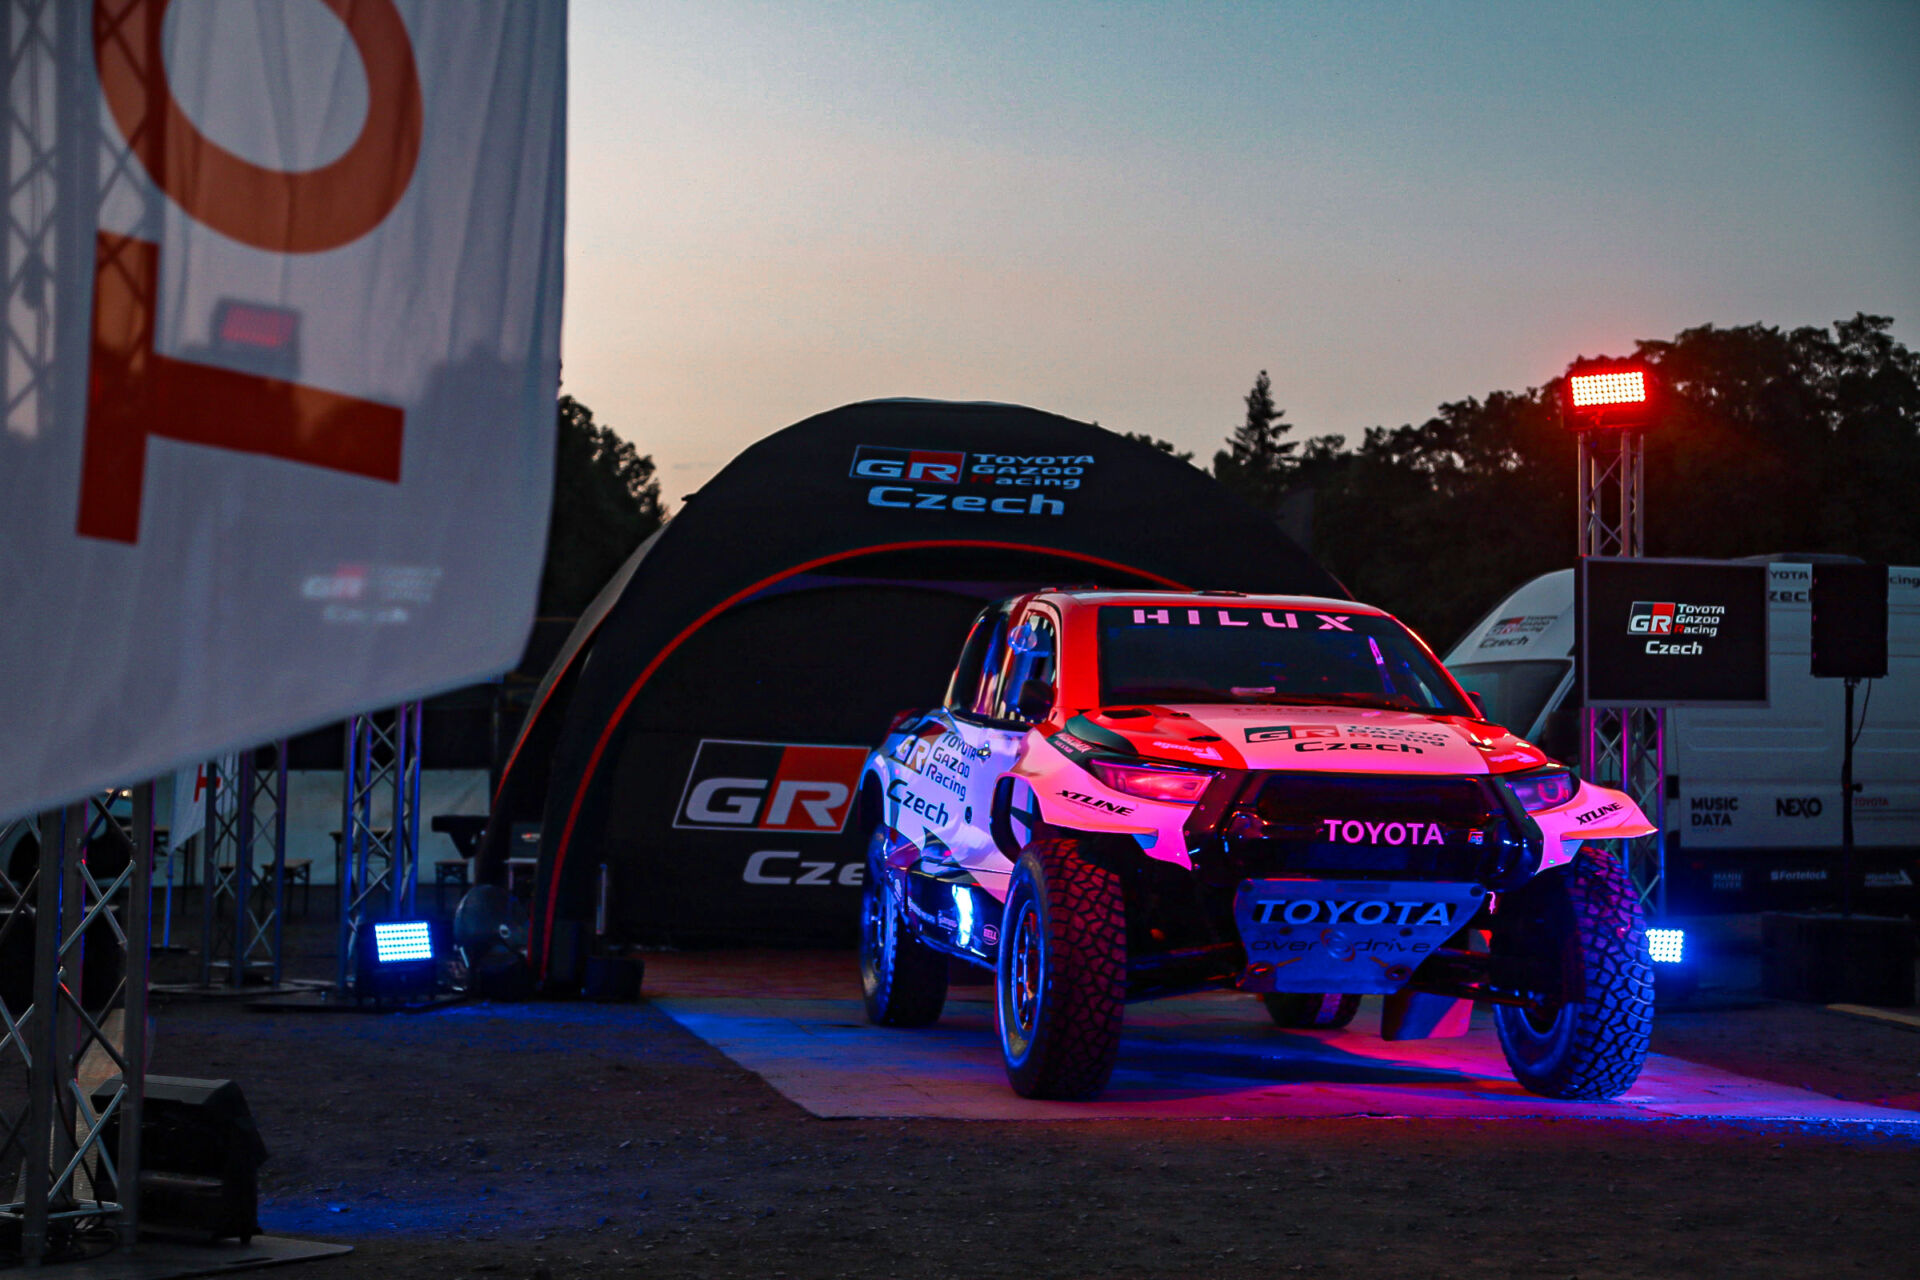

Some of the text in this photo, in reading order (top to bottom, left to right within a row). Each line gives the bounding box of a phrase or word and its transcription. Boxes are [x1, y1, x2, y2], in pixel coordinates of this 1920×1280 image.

[973, 453, 1095, 465] TOYOTA
[856, 459, 957, 481] GR
[971, 464, 1084, 476] GAZOO
[970, 475, 1081, 490] Racing
[867, 485, 1065, 515] Czech
[1677, 603, 1725, 614] TOYOTA
[1132, 608, 1354, 632] HILUX
[1631, 615, 1671, 632] GR
[1675, 614, 1720, 624] GAZOO
[1674, 624, 1718, 638] Racing
[1645, 640, 1703, 655] Czech
[1246, 728, 1338, 741] GR
[896, 735, 931, 772] GR
[943, 731, 977, 760] TOYOTA
[1295, 741, 1423, 754] Czech
[933, 747, 970, 778] GAZOO
[926, 763, 966, 801] Racing
[685, 777, 850, 828] GR
[887, 779, 948, 827] Czech
[1056, 790, 1134, 816] XTLINE
[1691, 797, 1738, 811] MUSIC
[1776, 798, 1822, 818] NEXO
[1576, 802, 1623, 825] XTLINE
[1691, 813, 1732, 826] DATA
[1324, 819, 1445, 846] TOYOTA
[1255, 900, 1450, 926] TOYOTA
[1252, 940, 1319, 951] over
